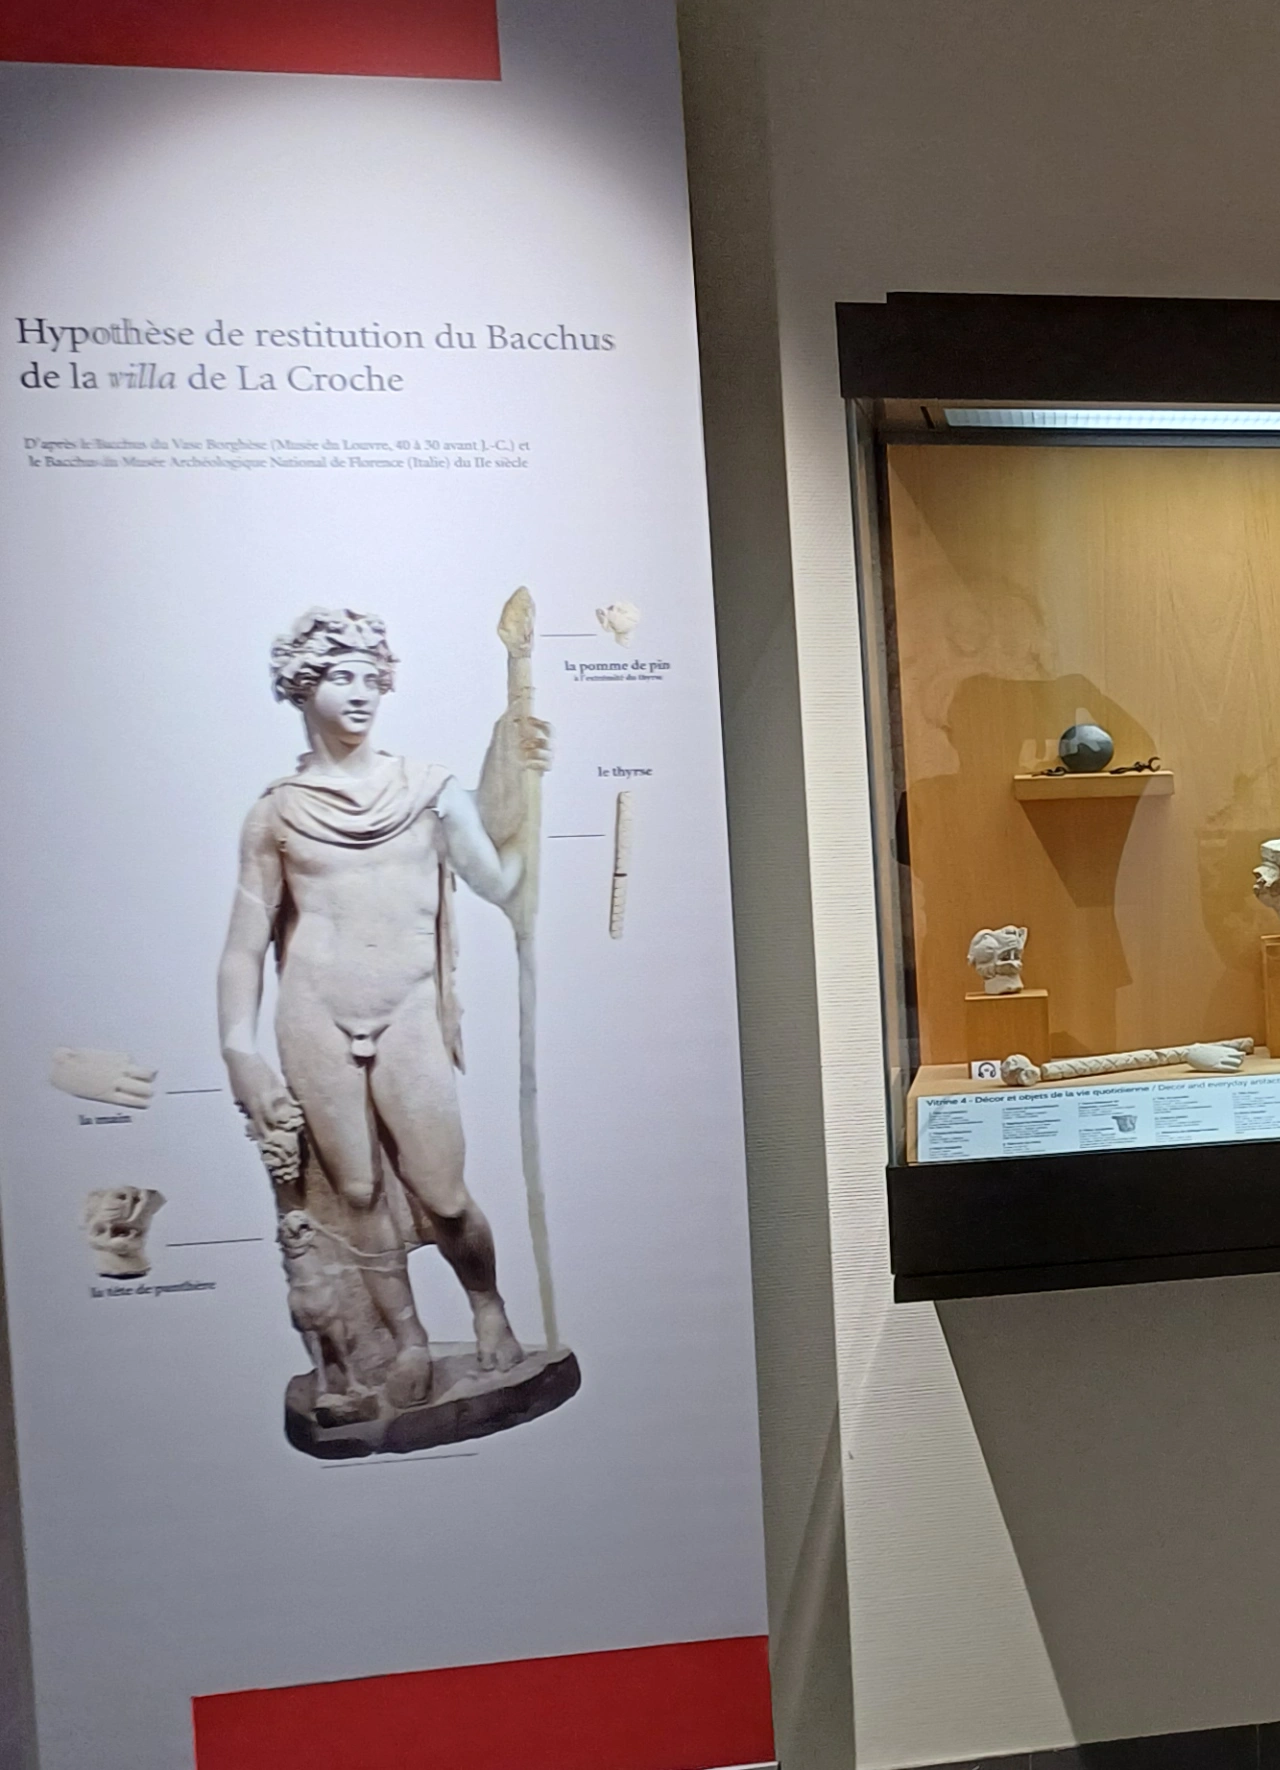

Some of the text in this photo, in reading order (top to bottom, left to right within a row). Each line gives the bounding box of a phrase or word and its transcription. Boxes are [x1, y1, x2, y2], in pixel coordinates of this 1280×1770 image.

[15, 317, 616, 353] Hypothèse de restitution du Bacchus
[20, 362, 404, 392] de la villa de La Croche
[343, 439, 393, 452] Louvre,
[443, 441, 477, 451] avant
[518, 441, 530, 451] et
[270, 457, 327, 468] National
[330, 457, 346, 468] de
[349, 457, 404, 468] Florence
[407, 457, 450, 470] (Italie)
[454, 457, 472, 468] du
[495, 457, 529, 468] siècle
[565, 659, 670, 674] la pomme de pin
[598, 766, 653, 779] le thyrse
[926, 1098, 958, 1106] Vitrine
[974, 1094, 1004, 1104] Décor
[1018, 1091, 1048, 1102] objets
[1050, 1090, 1062, 1098] de
[1076, 1088, 1090, 1096] vie
[1092, 1084, 1149, 1096] quotidienne
[1207, 1079, 1247, 1089] everyday
